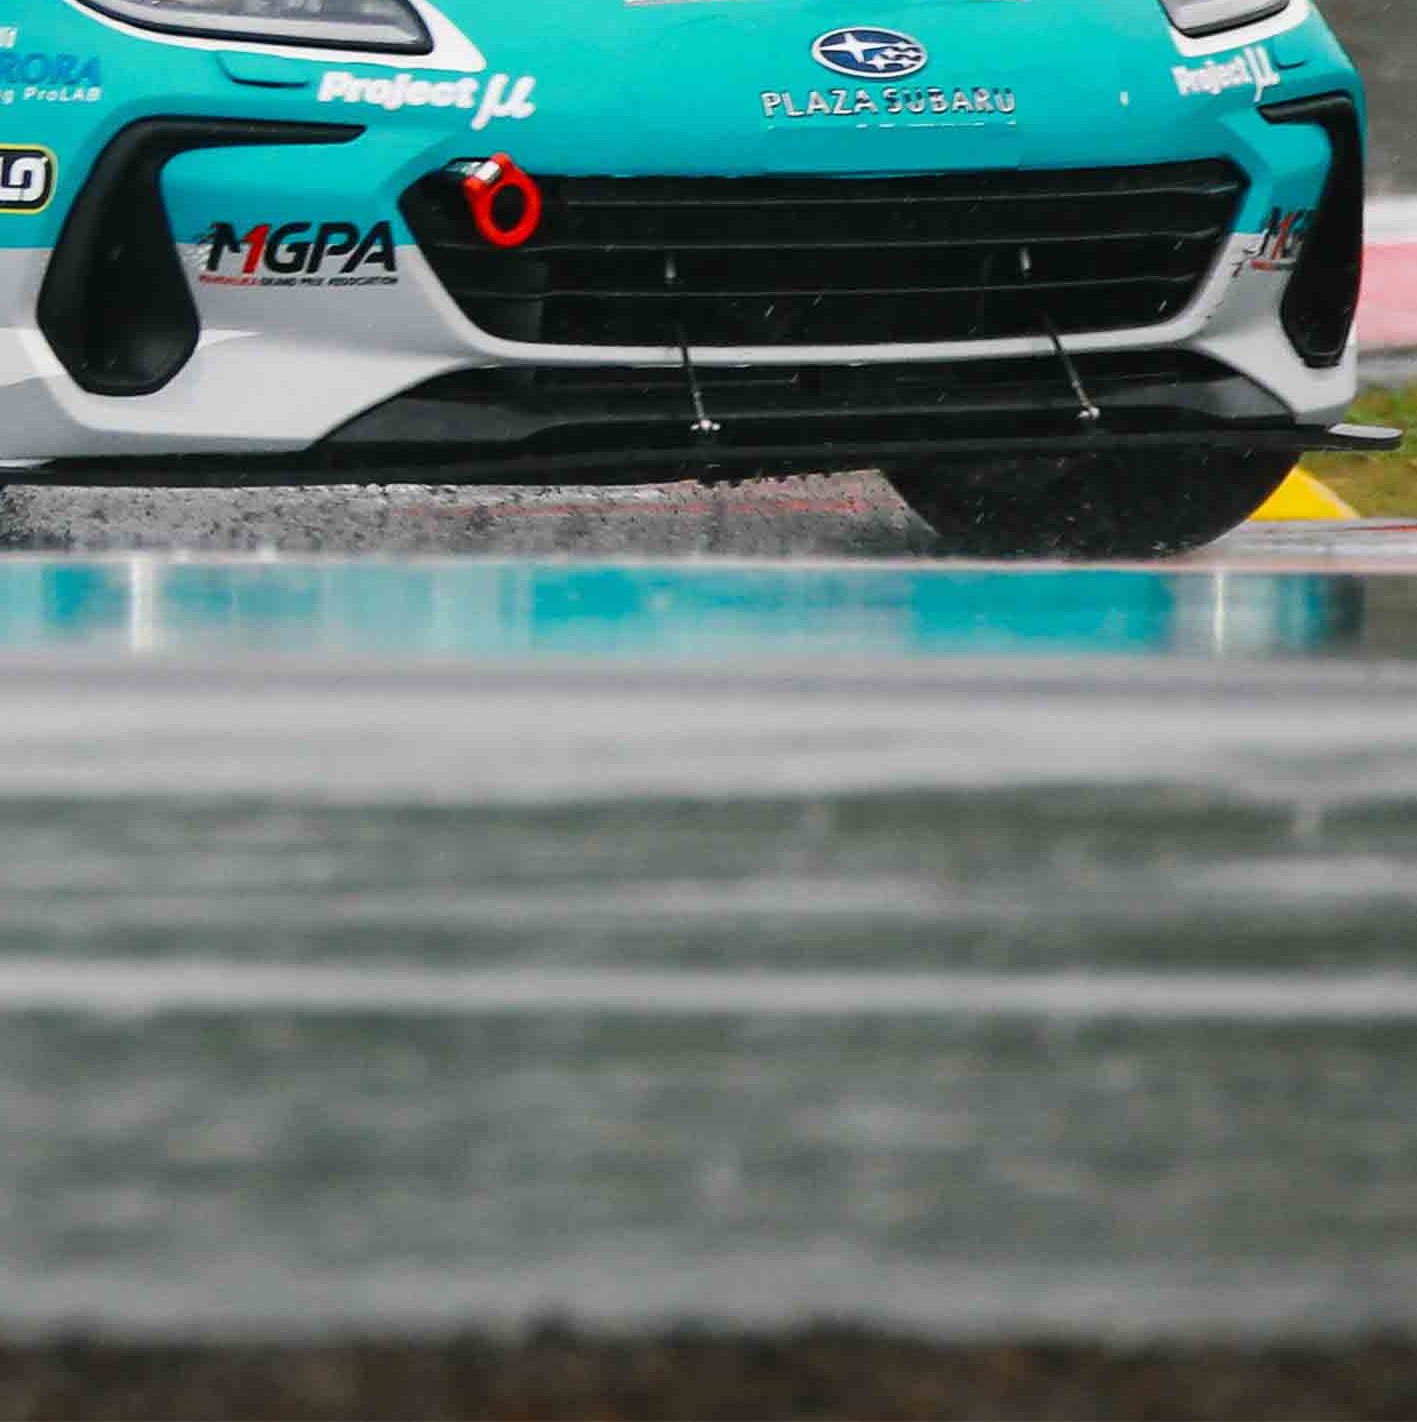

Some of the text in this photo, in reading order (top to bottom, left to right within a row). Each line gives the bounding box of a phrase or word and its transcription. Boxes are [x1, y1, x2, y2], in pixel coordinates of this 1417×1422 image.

[317, 72, 480, 113] Project
[759, 86, 1016, 117] PLAZA SUBARU
